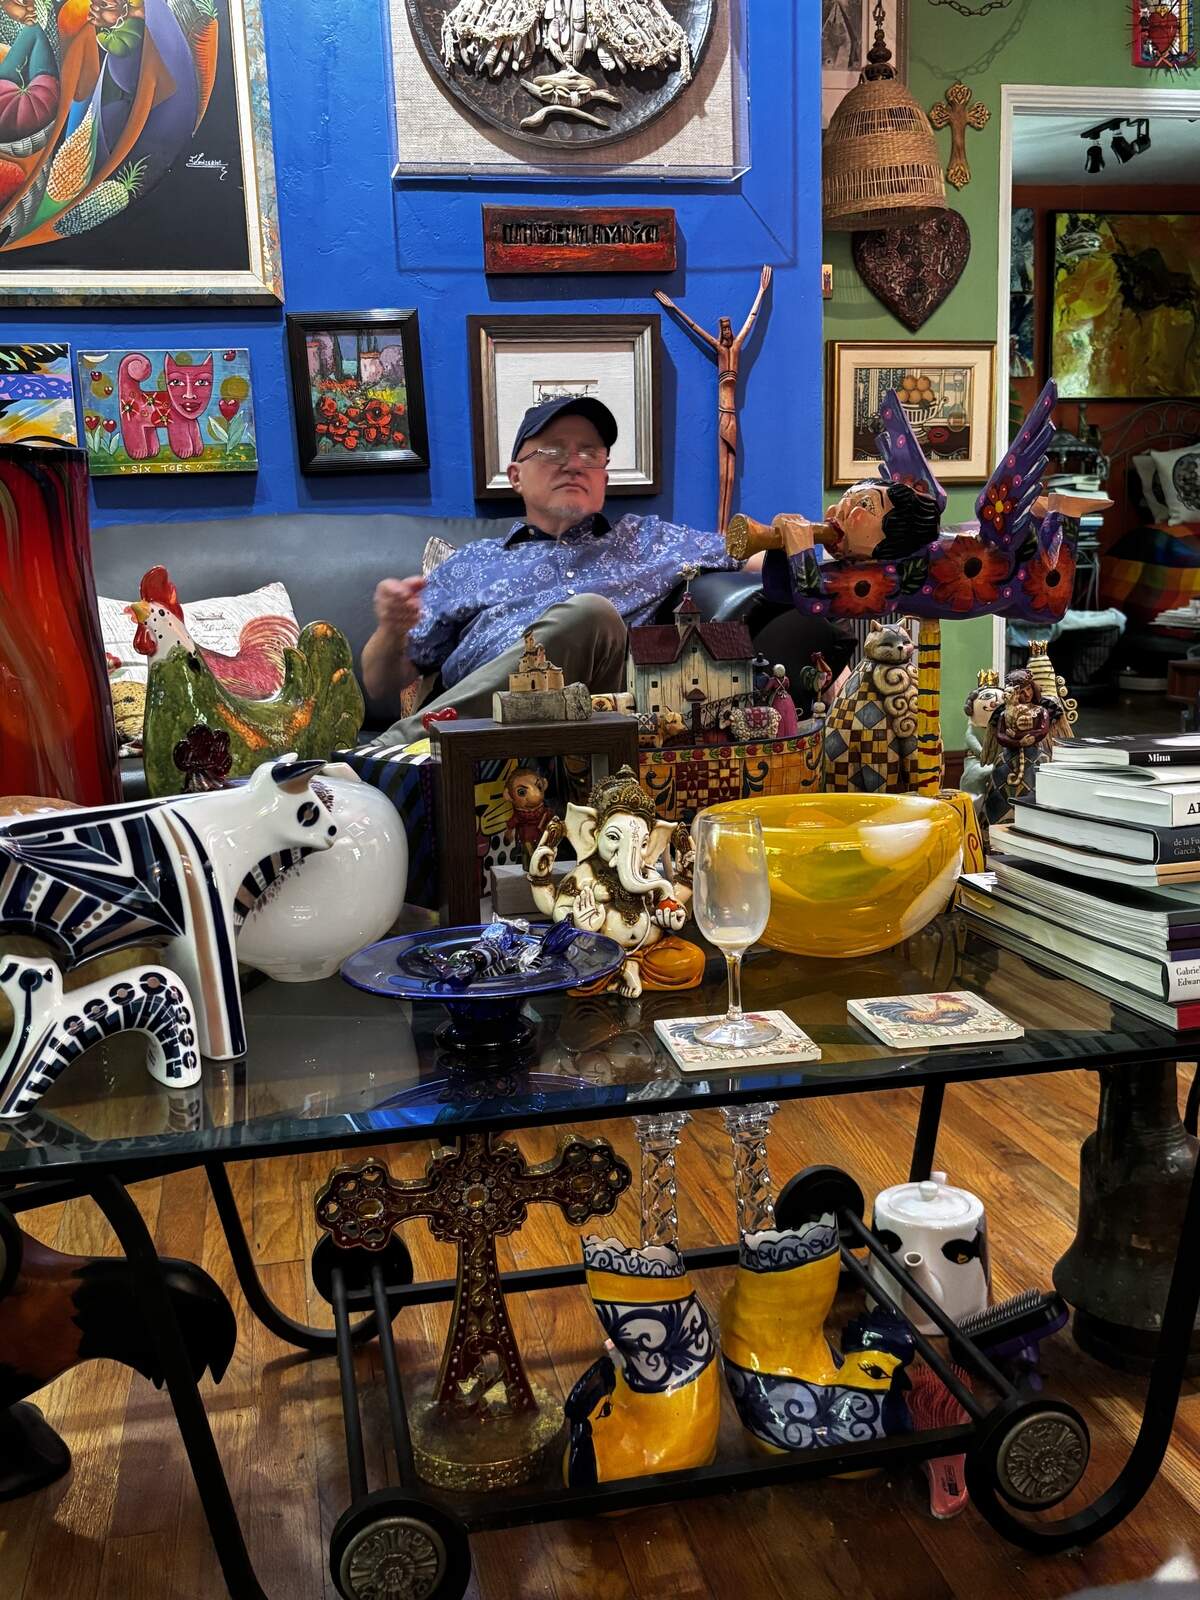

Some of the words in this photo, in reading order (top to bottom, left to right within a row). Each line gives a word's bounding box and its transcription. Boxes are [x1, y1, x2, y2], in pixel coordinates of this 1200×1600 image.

[1148, 753, 1171, 763] Mina
[1173, 838, 1182, 846] de
[1183, 837, 1190, 845] la
[1176, 966, 1200, 976] Gabrie
